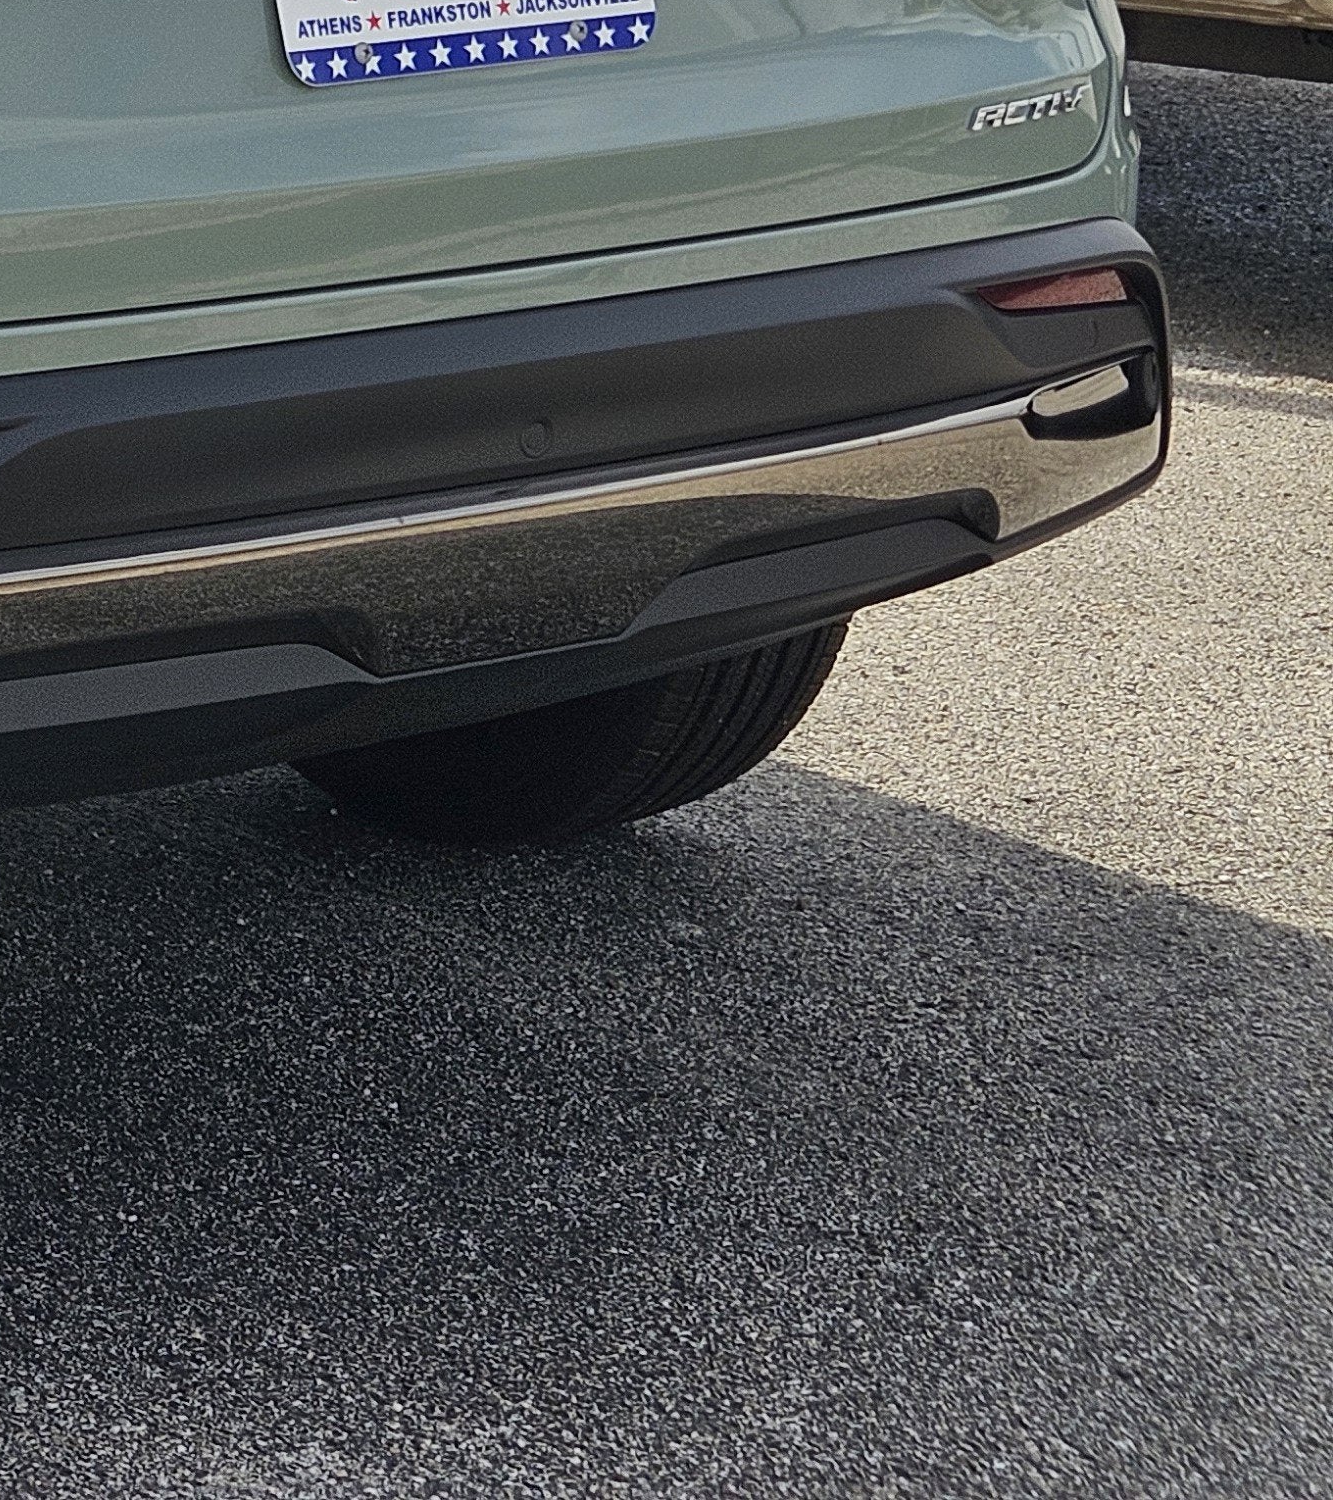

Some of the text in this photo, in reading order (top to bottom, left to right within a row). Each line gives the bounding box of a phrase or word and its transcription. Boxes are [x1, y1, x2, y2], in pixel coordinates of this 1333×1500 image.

[298, 15, 362, 39] ATHENS
[387, 1, 491, 29] FRANKSTON
[968, 83, 1090, 131] ACTIV
